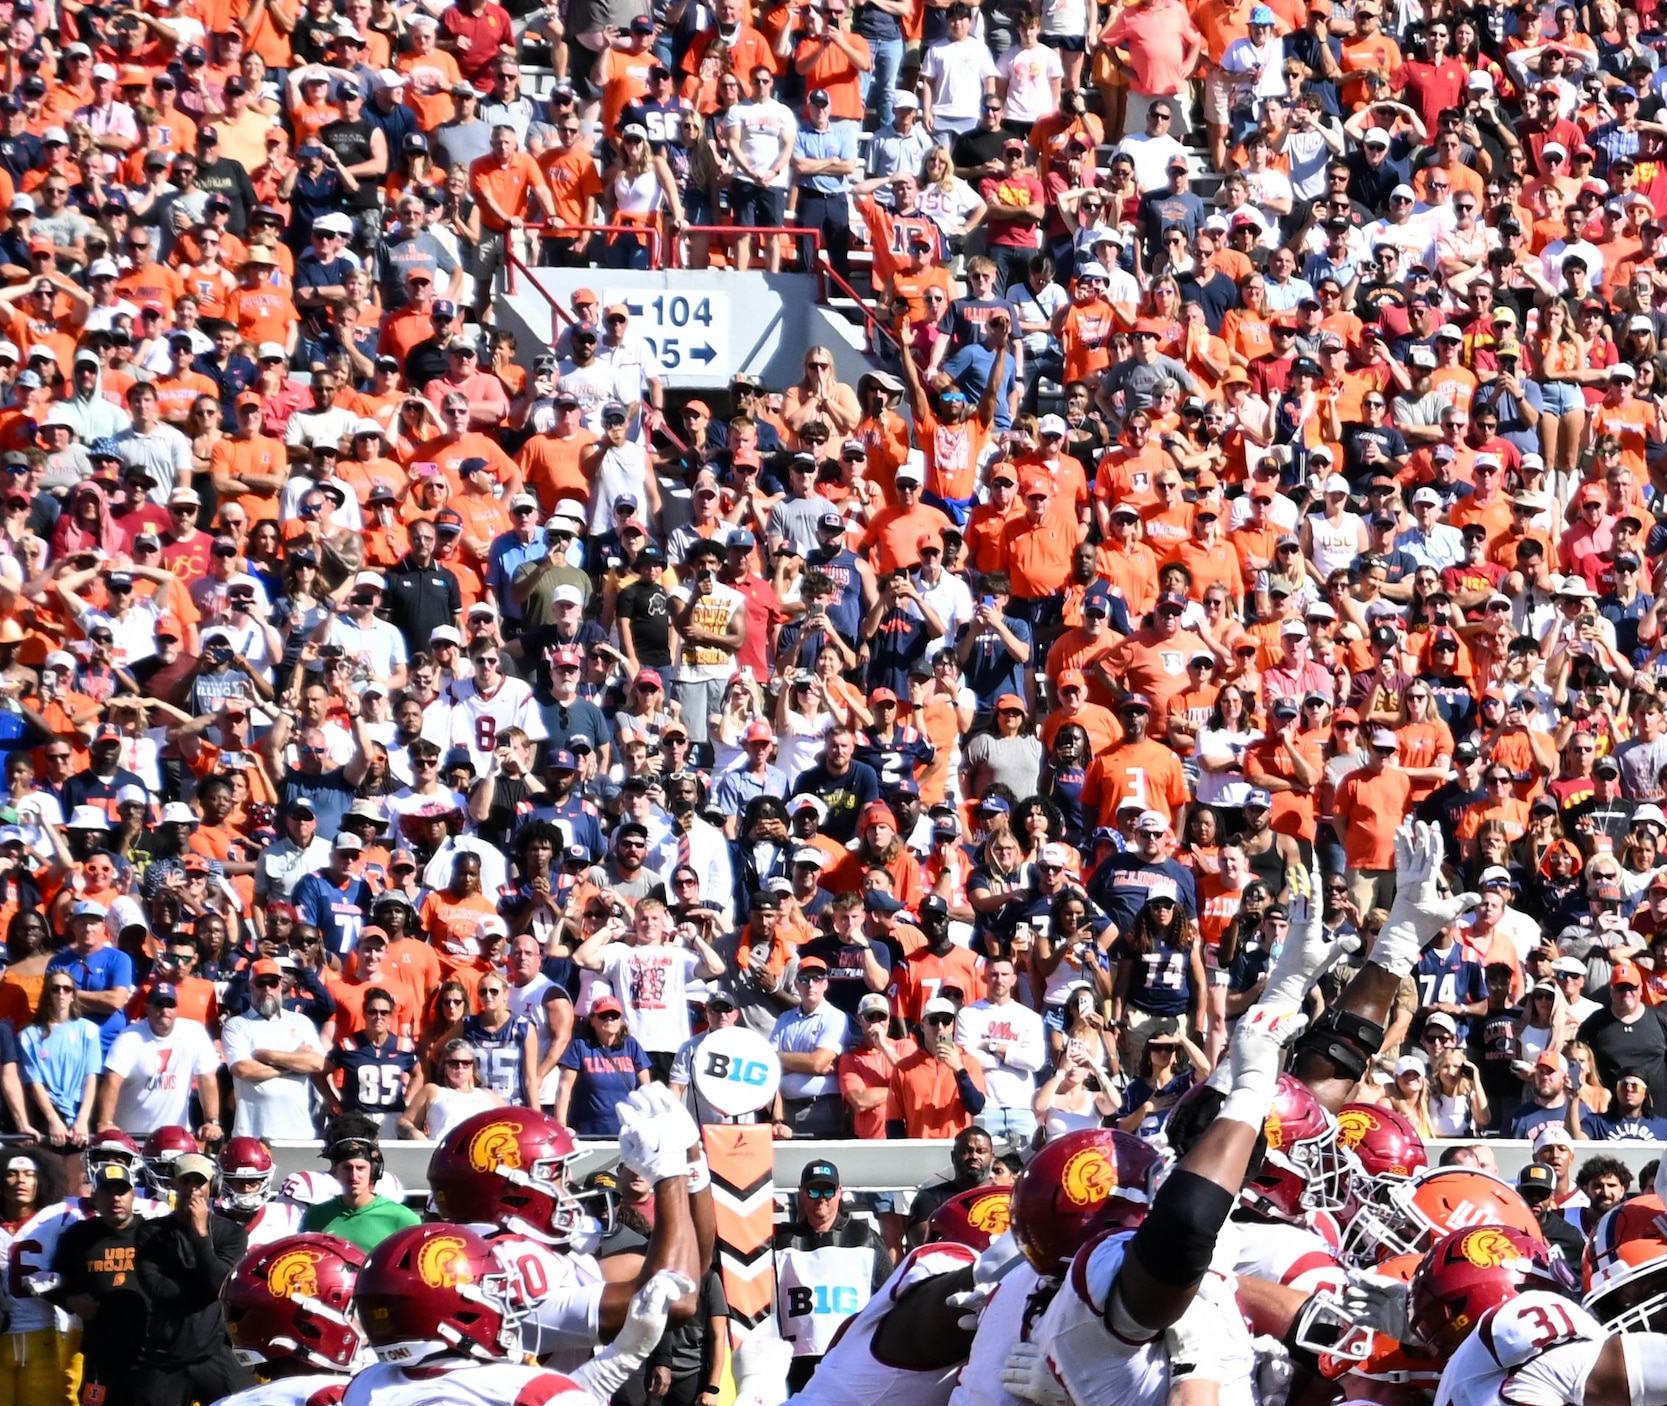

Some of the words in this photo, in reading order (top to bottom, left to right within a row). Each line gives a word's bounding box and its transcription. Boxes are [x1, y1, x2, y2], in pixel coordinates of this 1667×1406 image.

[652, 297, 711, 327] 104
[475, 716, 496, 752] 8
[1125, 767, 1146, 803] 3
[1141, 954, 1185, 990] 74
[1419, 971, 1458, 1007] 74
[356, 1065, 405, 1106] 85
[104, 1247, 137, 1261] USC
[1517, 1303, 1579, 1349] 31
